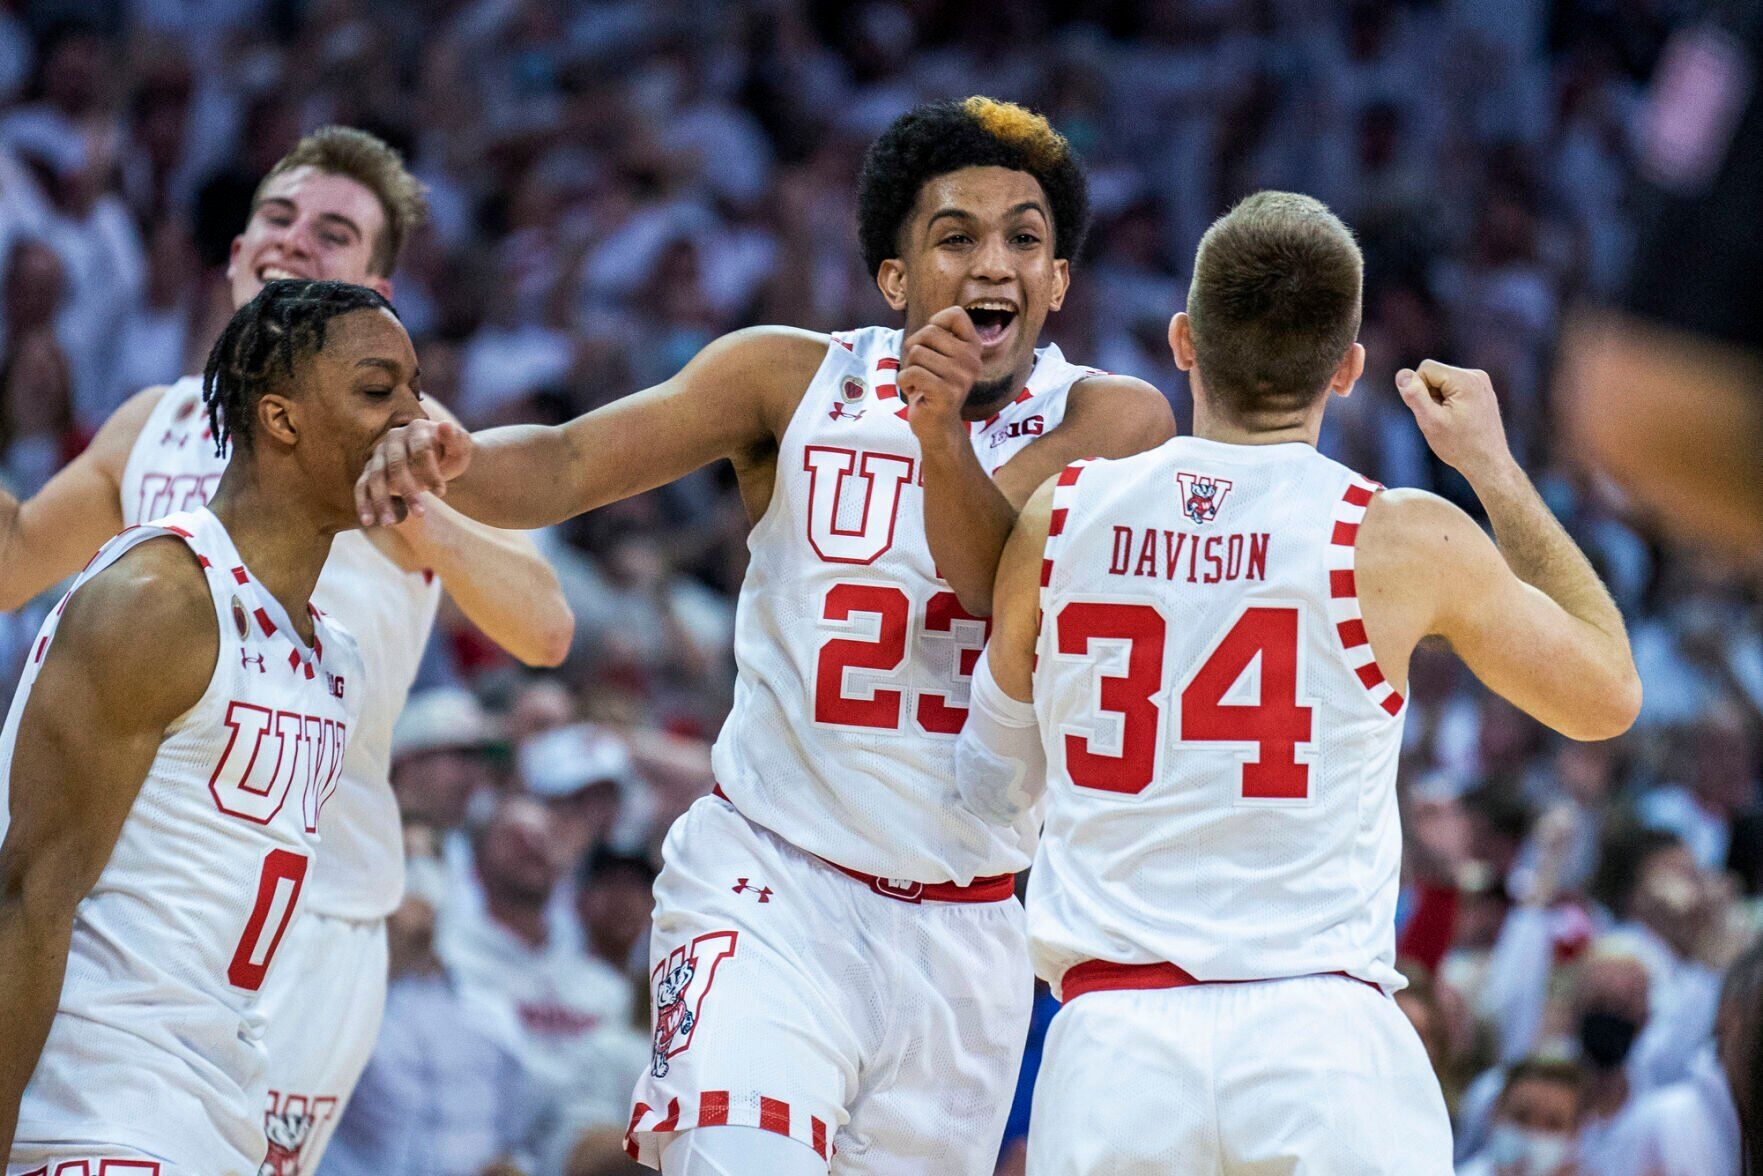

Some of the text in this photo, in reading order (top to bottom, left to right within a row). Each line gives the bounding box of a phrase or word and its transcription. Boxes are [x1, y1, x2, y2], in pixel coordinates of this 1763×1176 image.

[804, 445, 924, 565] U
[1109, 526, 1270, 584] DAVISON
[815, 583, 992, 734] 23
[1057, 602, 1312, 798] 34
[208, 700, 347, 833] UW
[228, 848, 309, 991] 0
